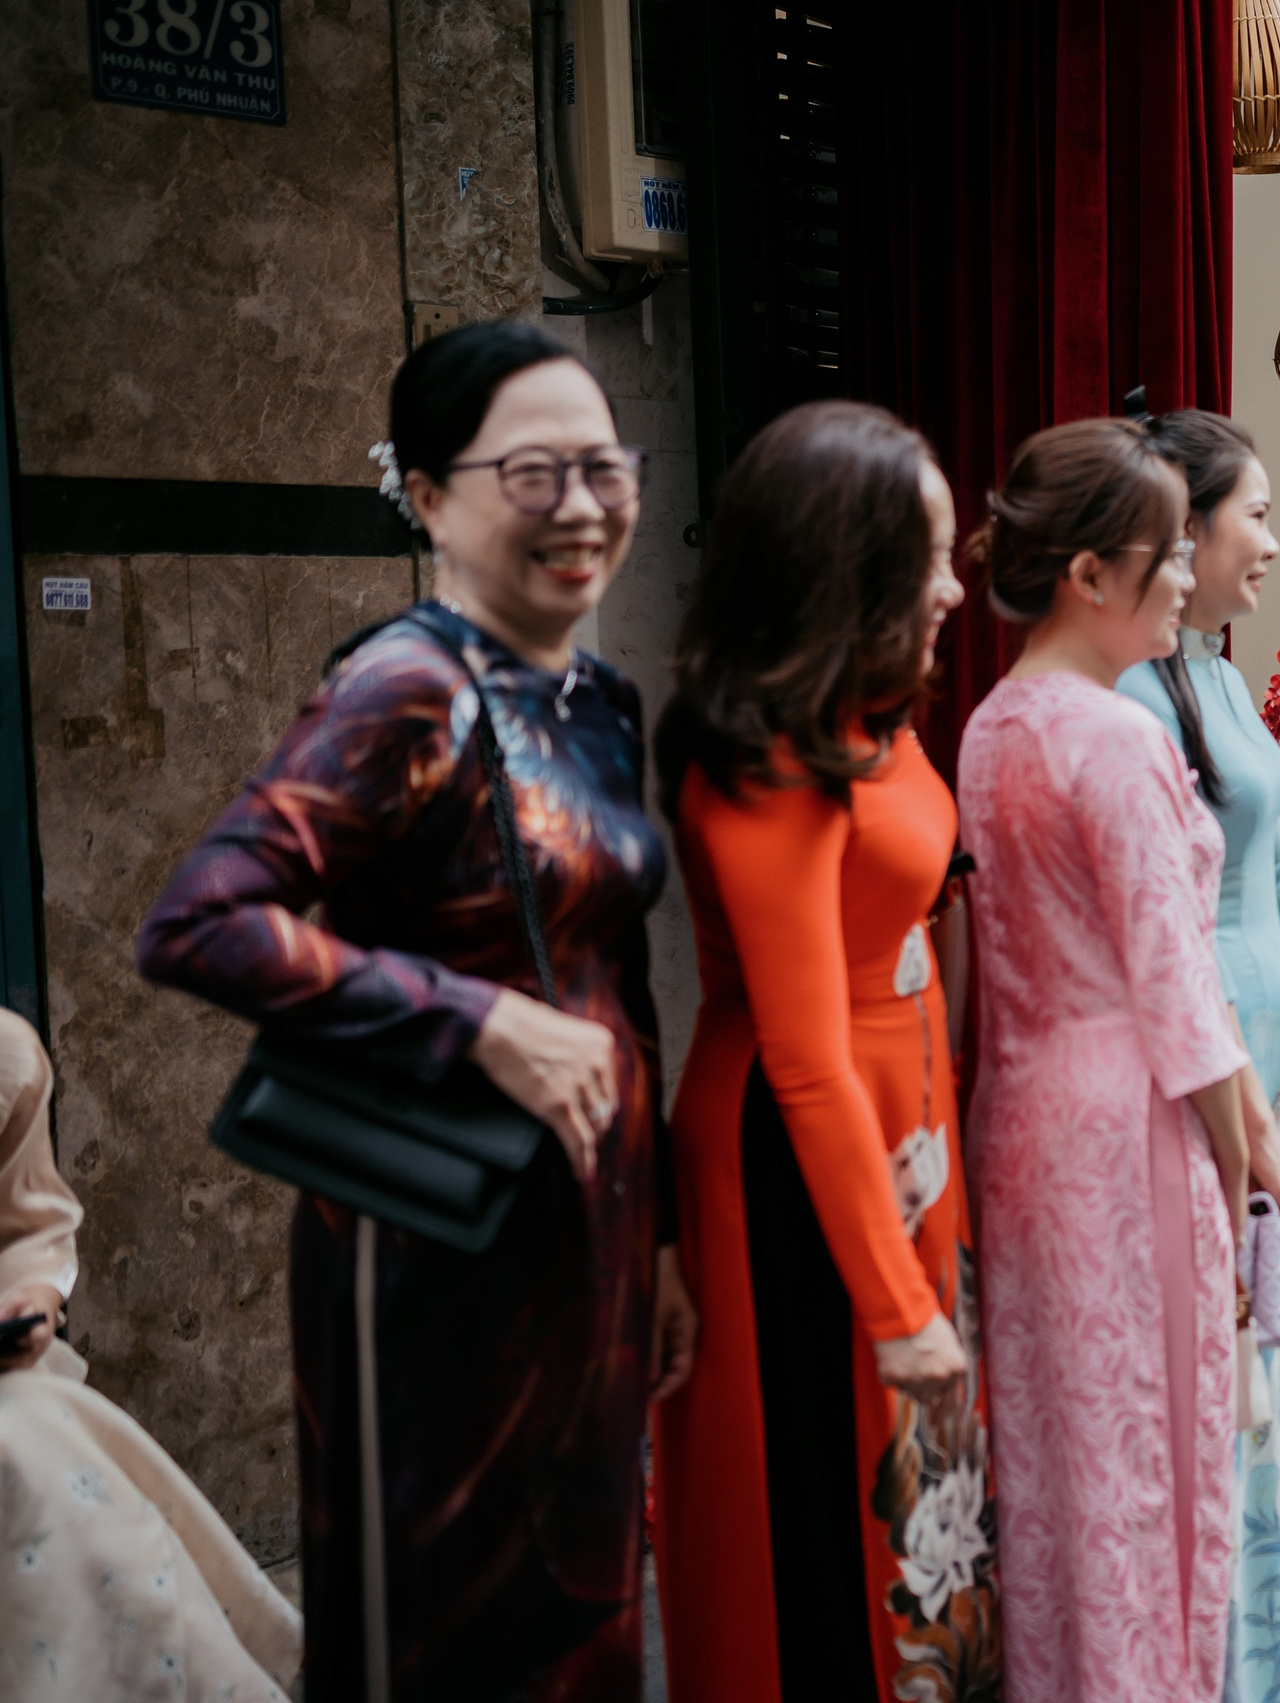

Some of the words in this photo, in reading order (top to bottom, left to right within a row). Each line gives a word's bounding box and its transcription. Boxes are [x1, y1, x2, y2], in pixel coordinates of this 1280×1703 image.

[103, 0, 272, 67] 38/3
[102, 51, 178, 75] HOÀNG
[184, 64, 227, 84] VĂN
[233, 72, 276, 93] THỤ
[110, 76, 138, 93] P.9
[176, 86, 210, 104] PHÚ
[215, 93, 271, 113] NHUẬN
